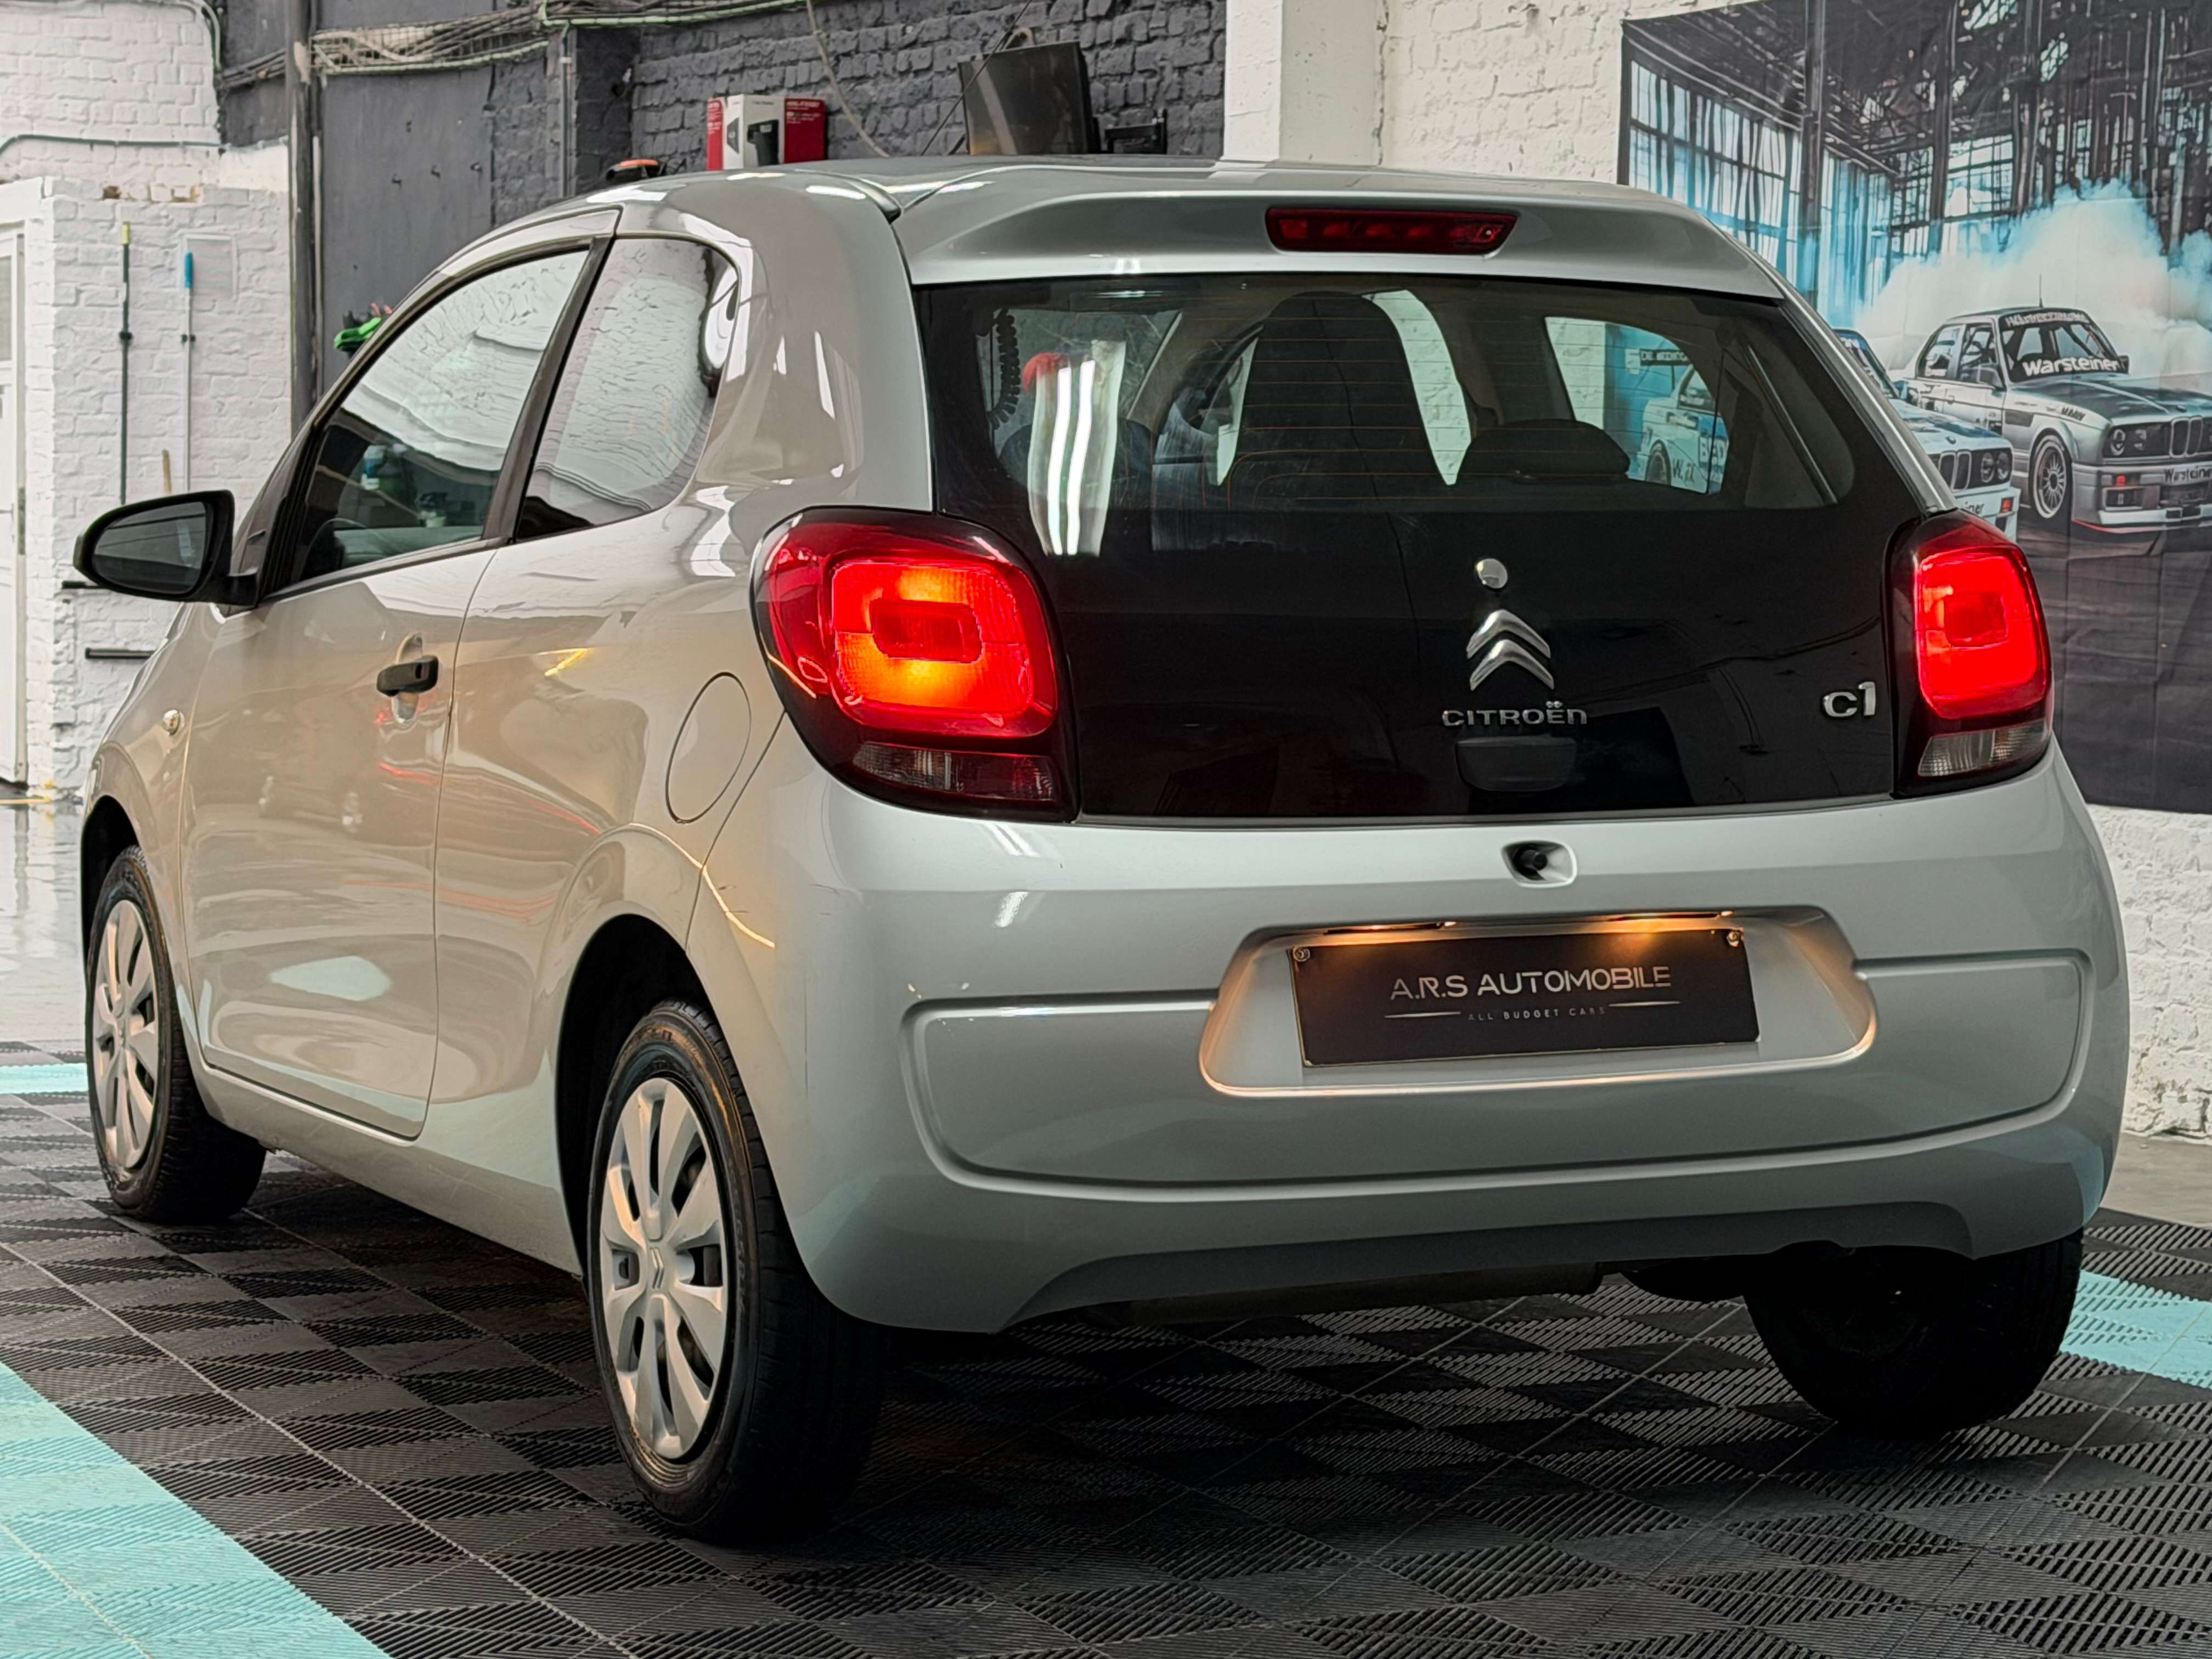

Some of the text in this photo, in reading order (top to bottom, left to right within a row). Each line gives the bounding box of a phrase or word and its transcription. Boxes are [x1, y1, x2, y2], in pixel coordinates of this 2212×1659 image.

[2022, 357, 2119, 376] Warsteiner
[1390, 967, 1671, 1000] A.R.S AUTOMOBILE
[1503, 1009, 1558, 1019] BUDGET
[1569, 1007, 1605, 1017] CARS
